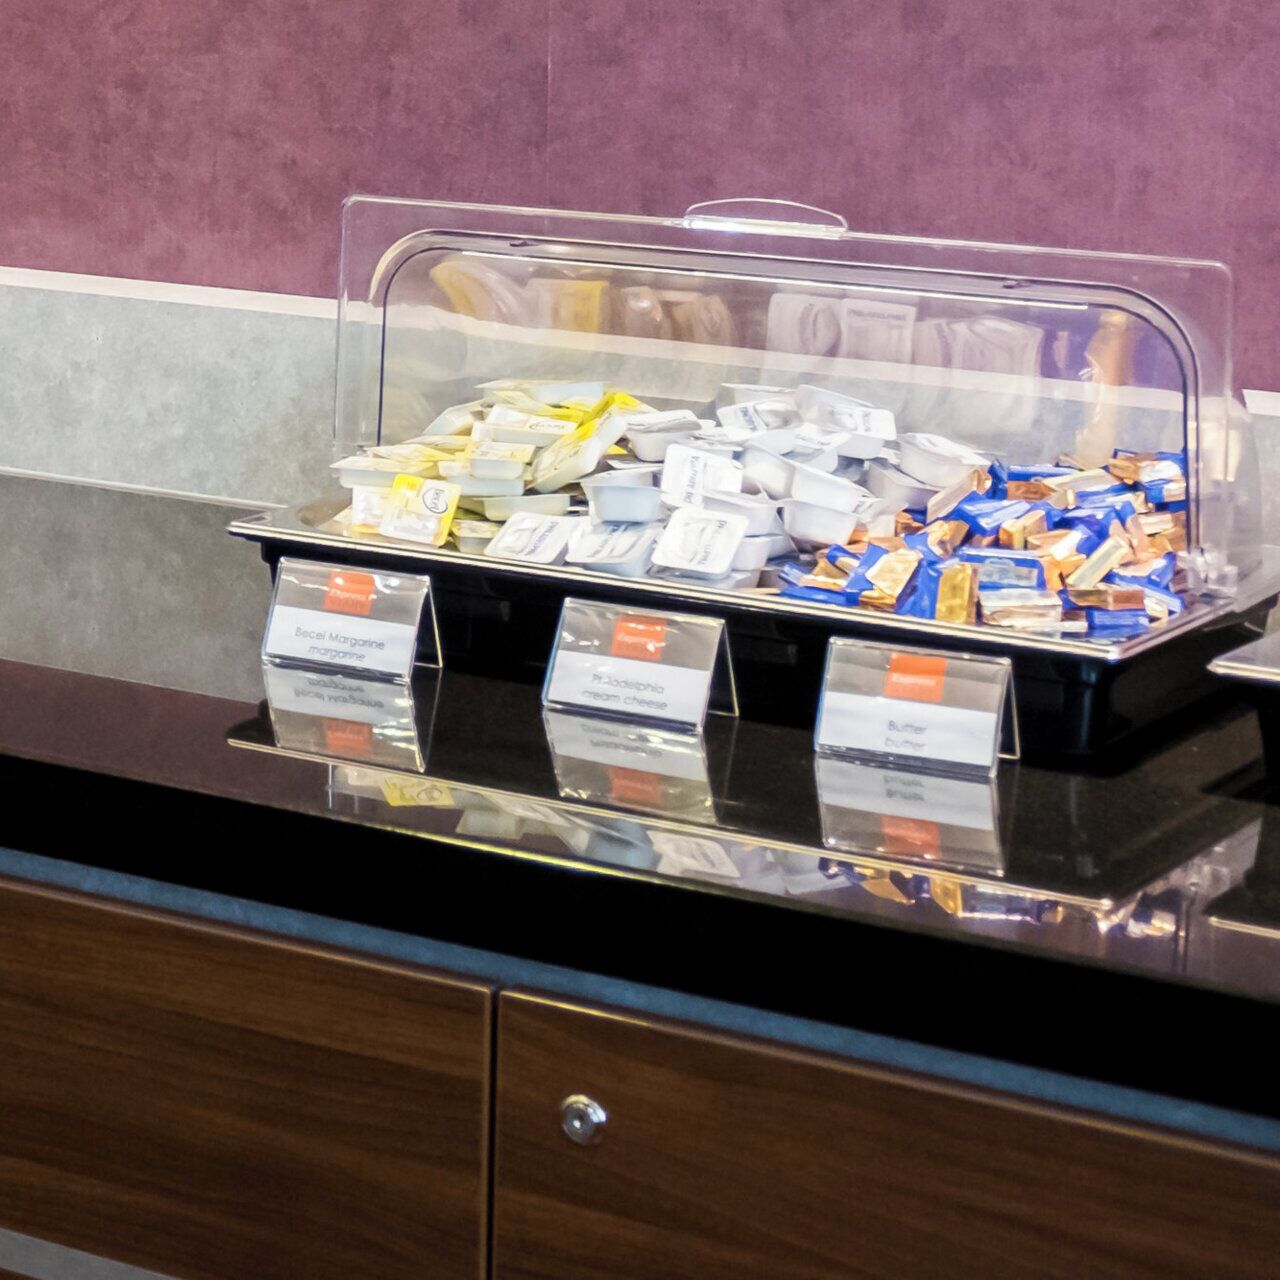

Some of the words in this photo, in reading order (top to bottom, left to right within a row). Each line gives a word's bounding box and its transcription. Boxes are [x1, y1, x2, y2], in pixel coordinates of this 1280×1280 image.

[294, 626, 326, 641] Becel
[329, 631, 386, 651] Margarine
[308, 645, 367, 662] margarine
[582, 690, 621, 705] cream
[623, 695, 669, 711] cheese
[888, 719, 928, 735] Butter
[885, 737, 927, 750] butter
